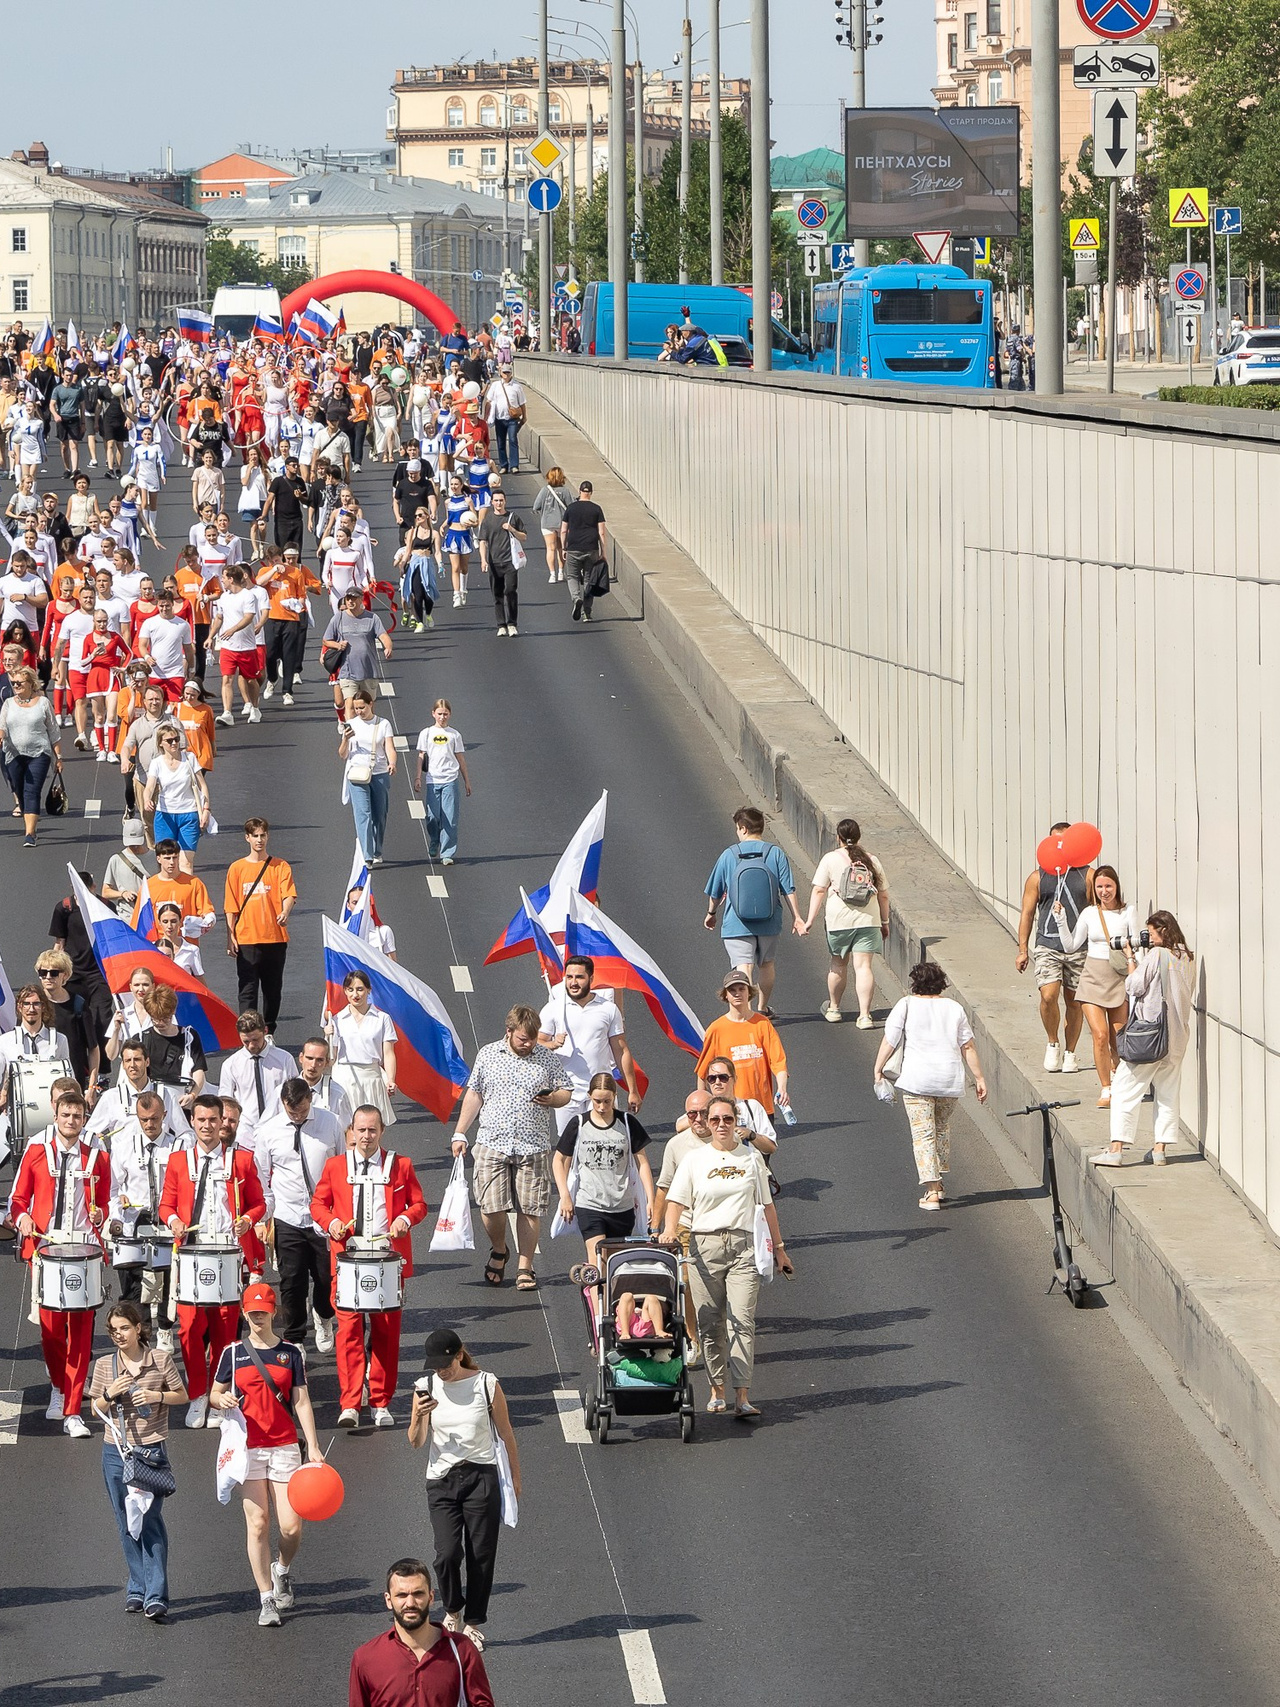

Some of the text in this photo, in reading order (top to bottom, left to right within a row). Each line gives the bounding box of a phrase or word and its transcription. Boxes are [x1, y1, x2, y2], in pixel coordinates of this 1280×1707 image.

[977, 117, 1014, 125] ПРОДАЖ
[855, 155, 951, 169] ПЕНТХАУСЫ
[908, 170, 965, 190] Stories
